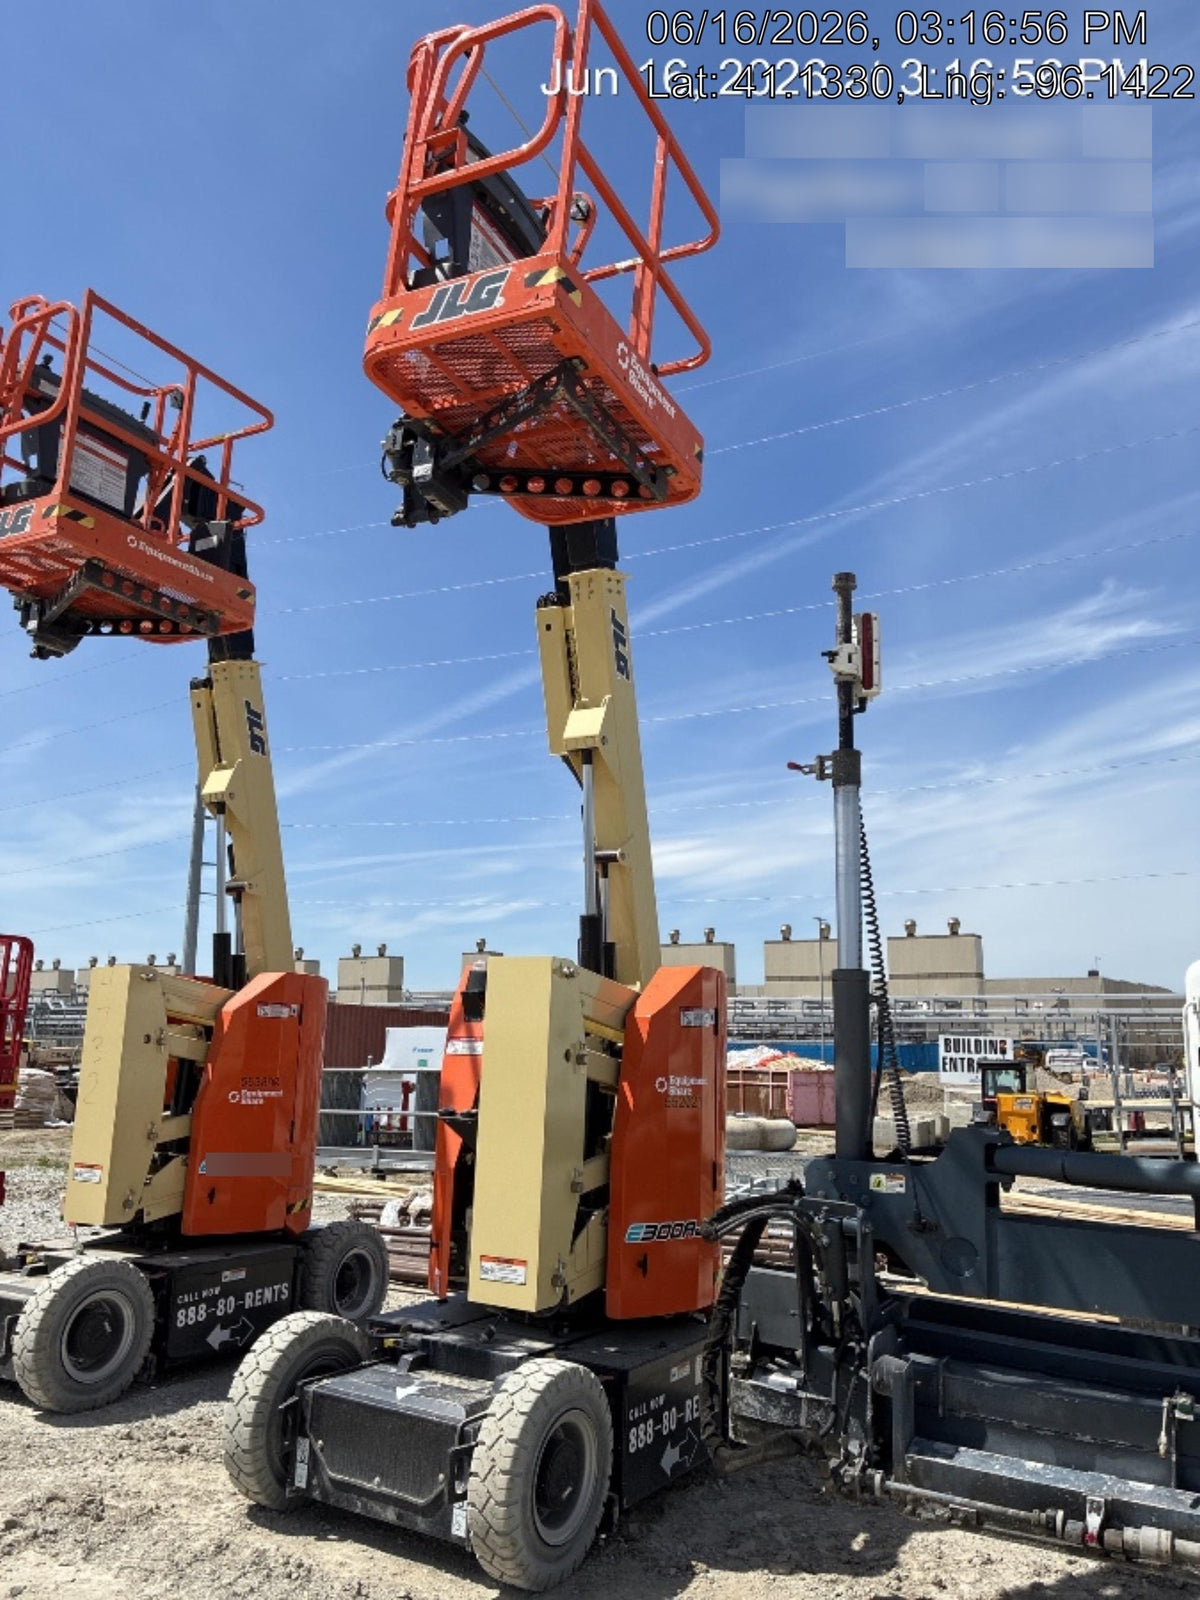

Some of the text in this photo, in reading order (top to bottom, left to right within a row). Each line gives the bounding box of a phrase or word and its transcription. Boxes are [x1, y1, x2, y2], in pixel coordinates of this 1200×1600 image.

[408, 267, 513, 331] JLG
[0, 502, 36, 540] LG
[609, 606, 631, 682] JLG
[244, 699, 267, 757] JLG
[176, 1283, 289, 1327] 888-80-RENTS
[177, 1286, 221, 1304] CALL NOW
[629, 1402, 647, 1421] CALL
